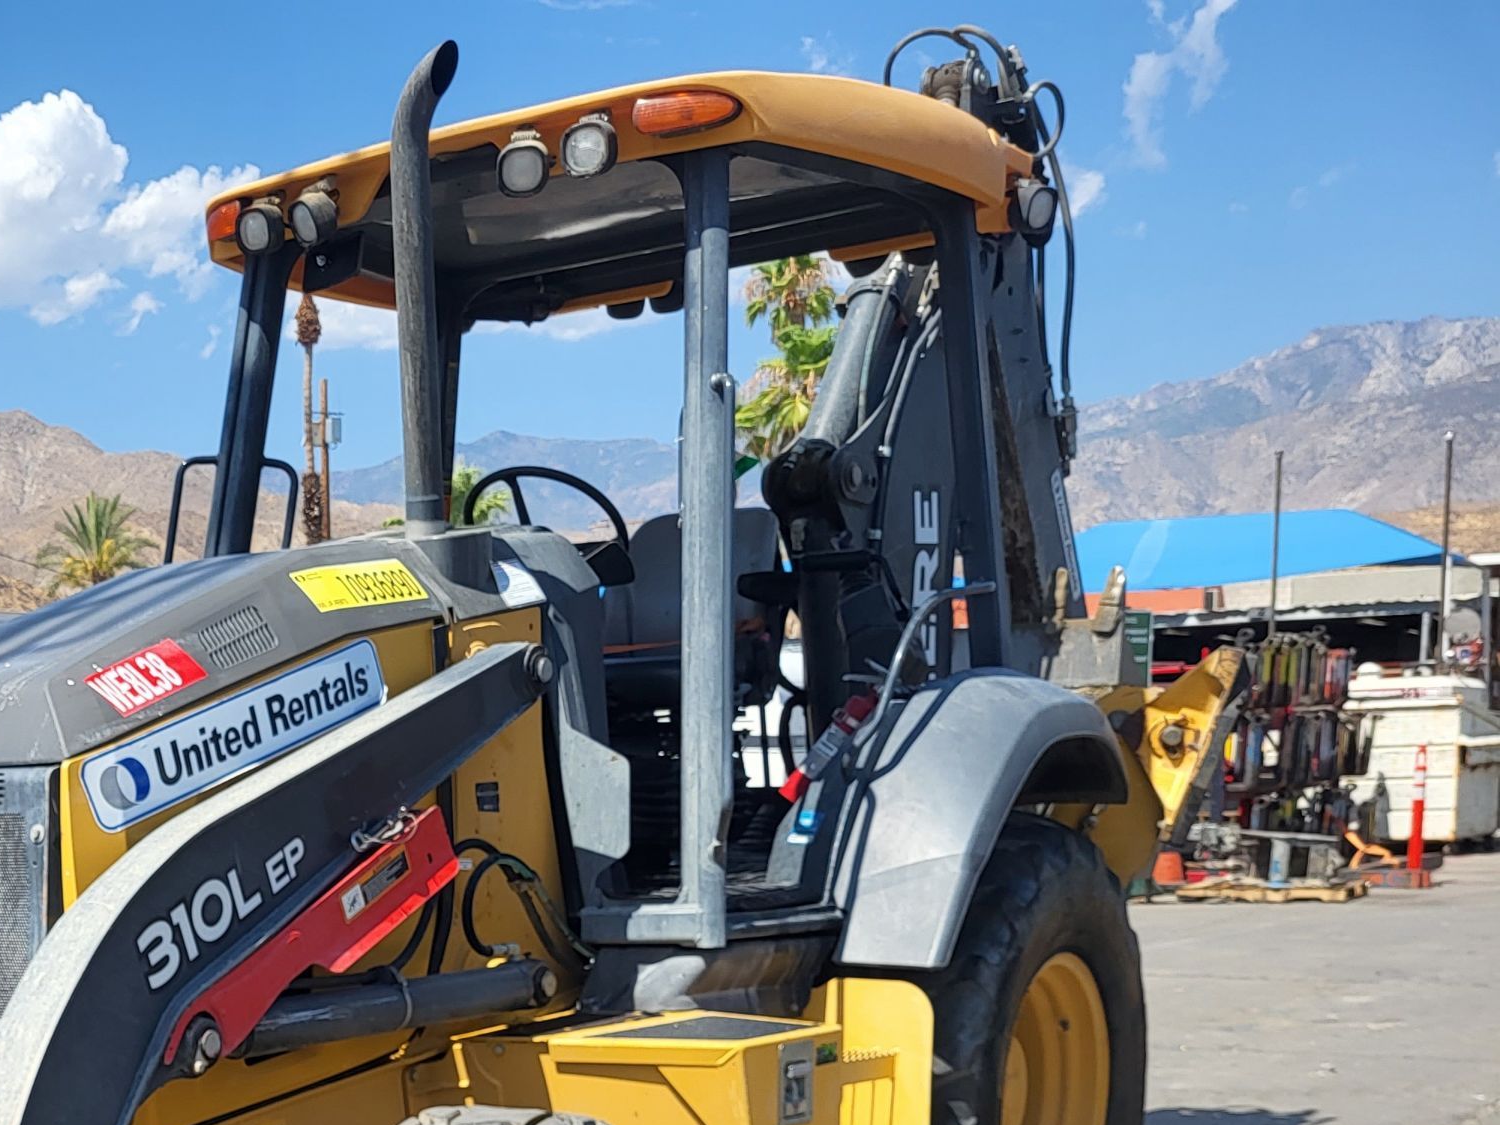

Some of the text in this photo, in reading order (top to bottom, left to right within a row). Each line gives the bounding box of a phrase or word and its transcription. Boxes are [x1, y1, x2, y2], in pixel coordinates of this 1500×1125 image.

[335, 568, 422, 604] 10936890
[87, 651, 183, 713] WE8L38
[153, 661, 369, 786] United Rentals
[136, 868, 263, 990] 310L
[264, 836, 305, 895] EP
